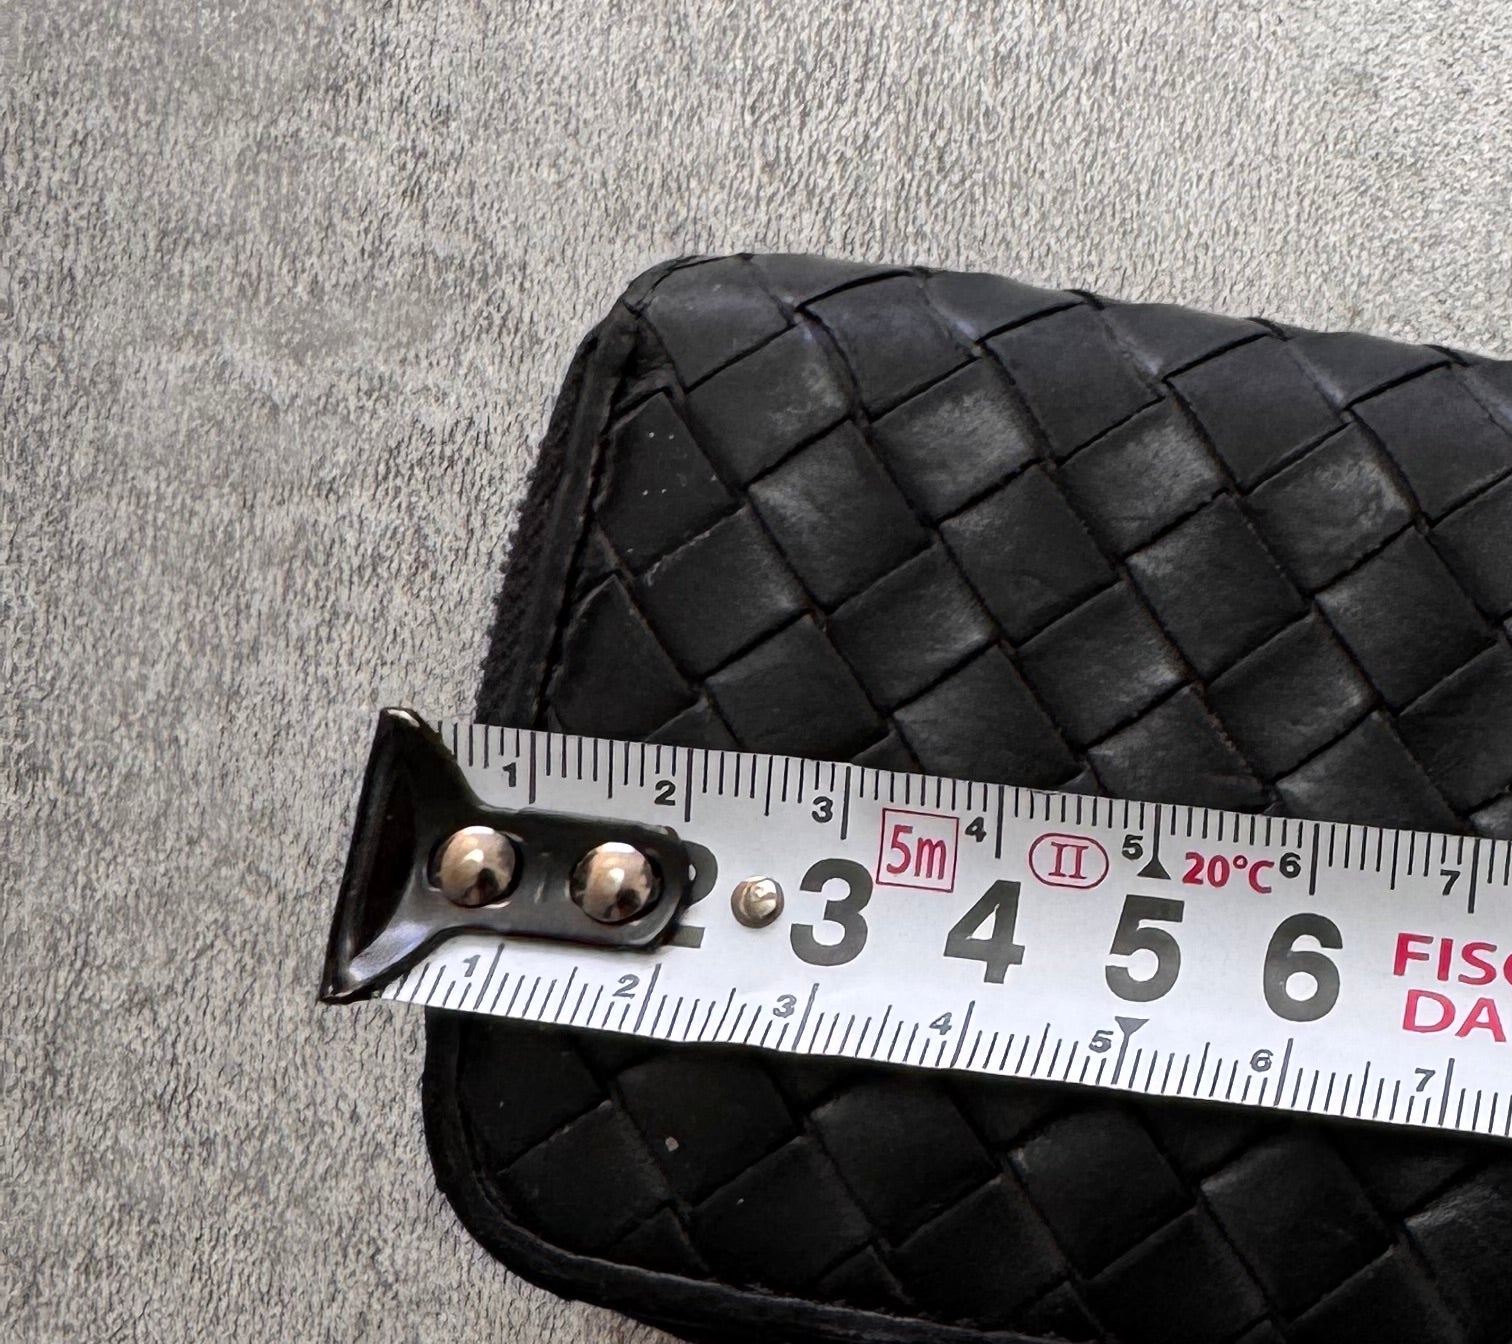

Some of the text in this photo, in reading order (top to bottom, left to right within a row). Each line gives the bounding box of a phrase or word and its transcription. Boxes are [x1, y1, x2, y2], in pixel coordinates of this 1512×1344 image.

[502, 761, 517, 787] 1
[655, 780, 677, 806] 2
[812, 797, 834, 823] 3
[965, 817, 987, 843] 4
[1122, 835, 1144, 861] 5
[1279, 853, 1301, 879] 6
[1440, 869, 1461, 896] 7
[885, 824, 947, 881] 5m
[1182, 851, 1274, 894] 20°C
[789, 857, 874, 967] 3
[943, 879, 1026, 984] 4
[1104, 894, 1185, 1003] 5
[1262, 912, 1344, 1022] 6
[461, 954, 481, 978] 1
[612, 974, 639, 998] 2
[772, 994, 796, 1019] 3
[928, 1012, 953, 1036] 4
[1087, 1030, 1113, 1053] 5
[1250, 1049, 1274, 1073] 6
[1413, 1068, 1436, 1093] 7
